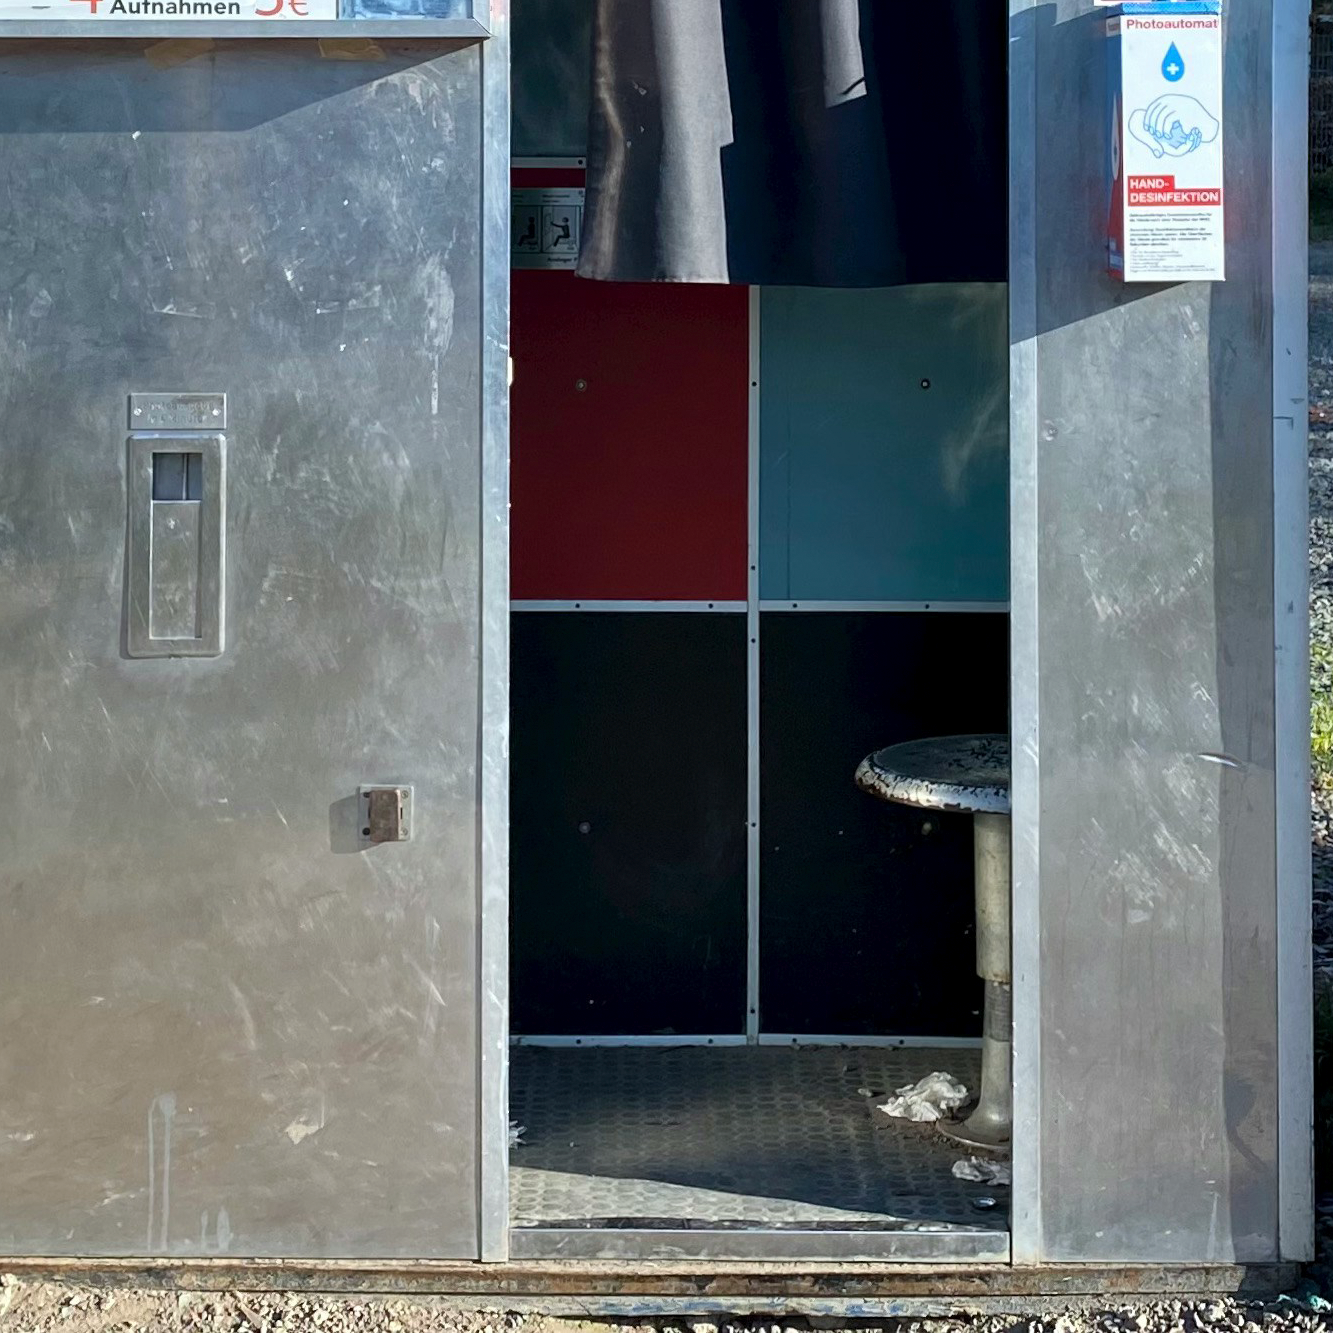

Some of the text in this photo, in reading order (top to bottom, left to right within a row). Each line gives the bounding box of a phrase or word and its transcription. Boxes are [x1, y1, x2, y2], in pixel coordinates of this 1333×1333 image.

[1127, 19, 1218, 29] Photoautomat
[1130, 178, 1169, 189] HAND-
[1130, 192, 1218, 202] DESINFEKTION
